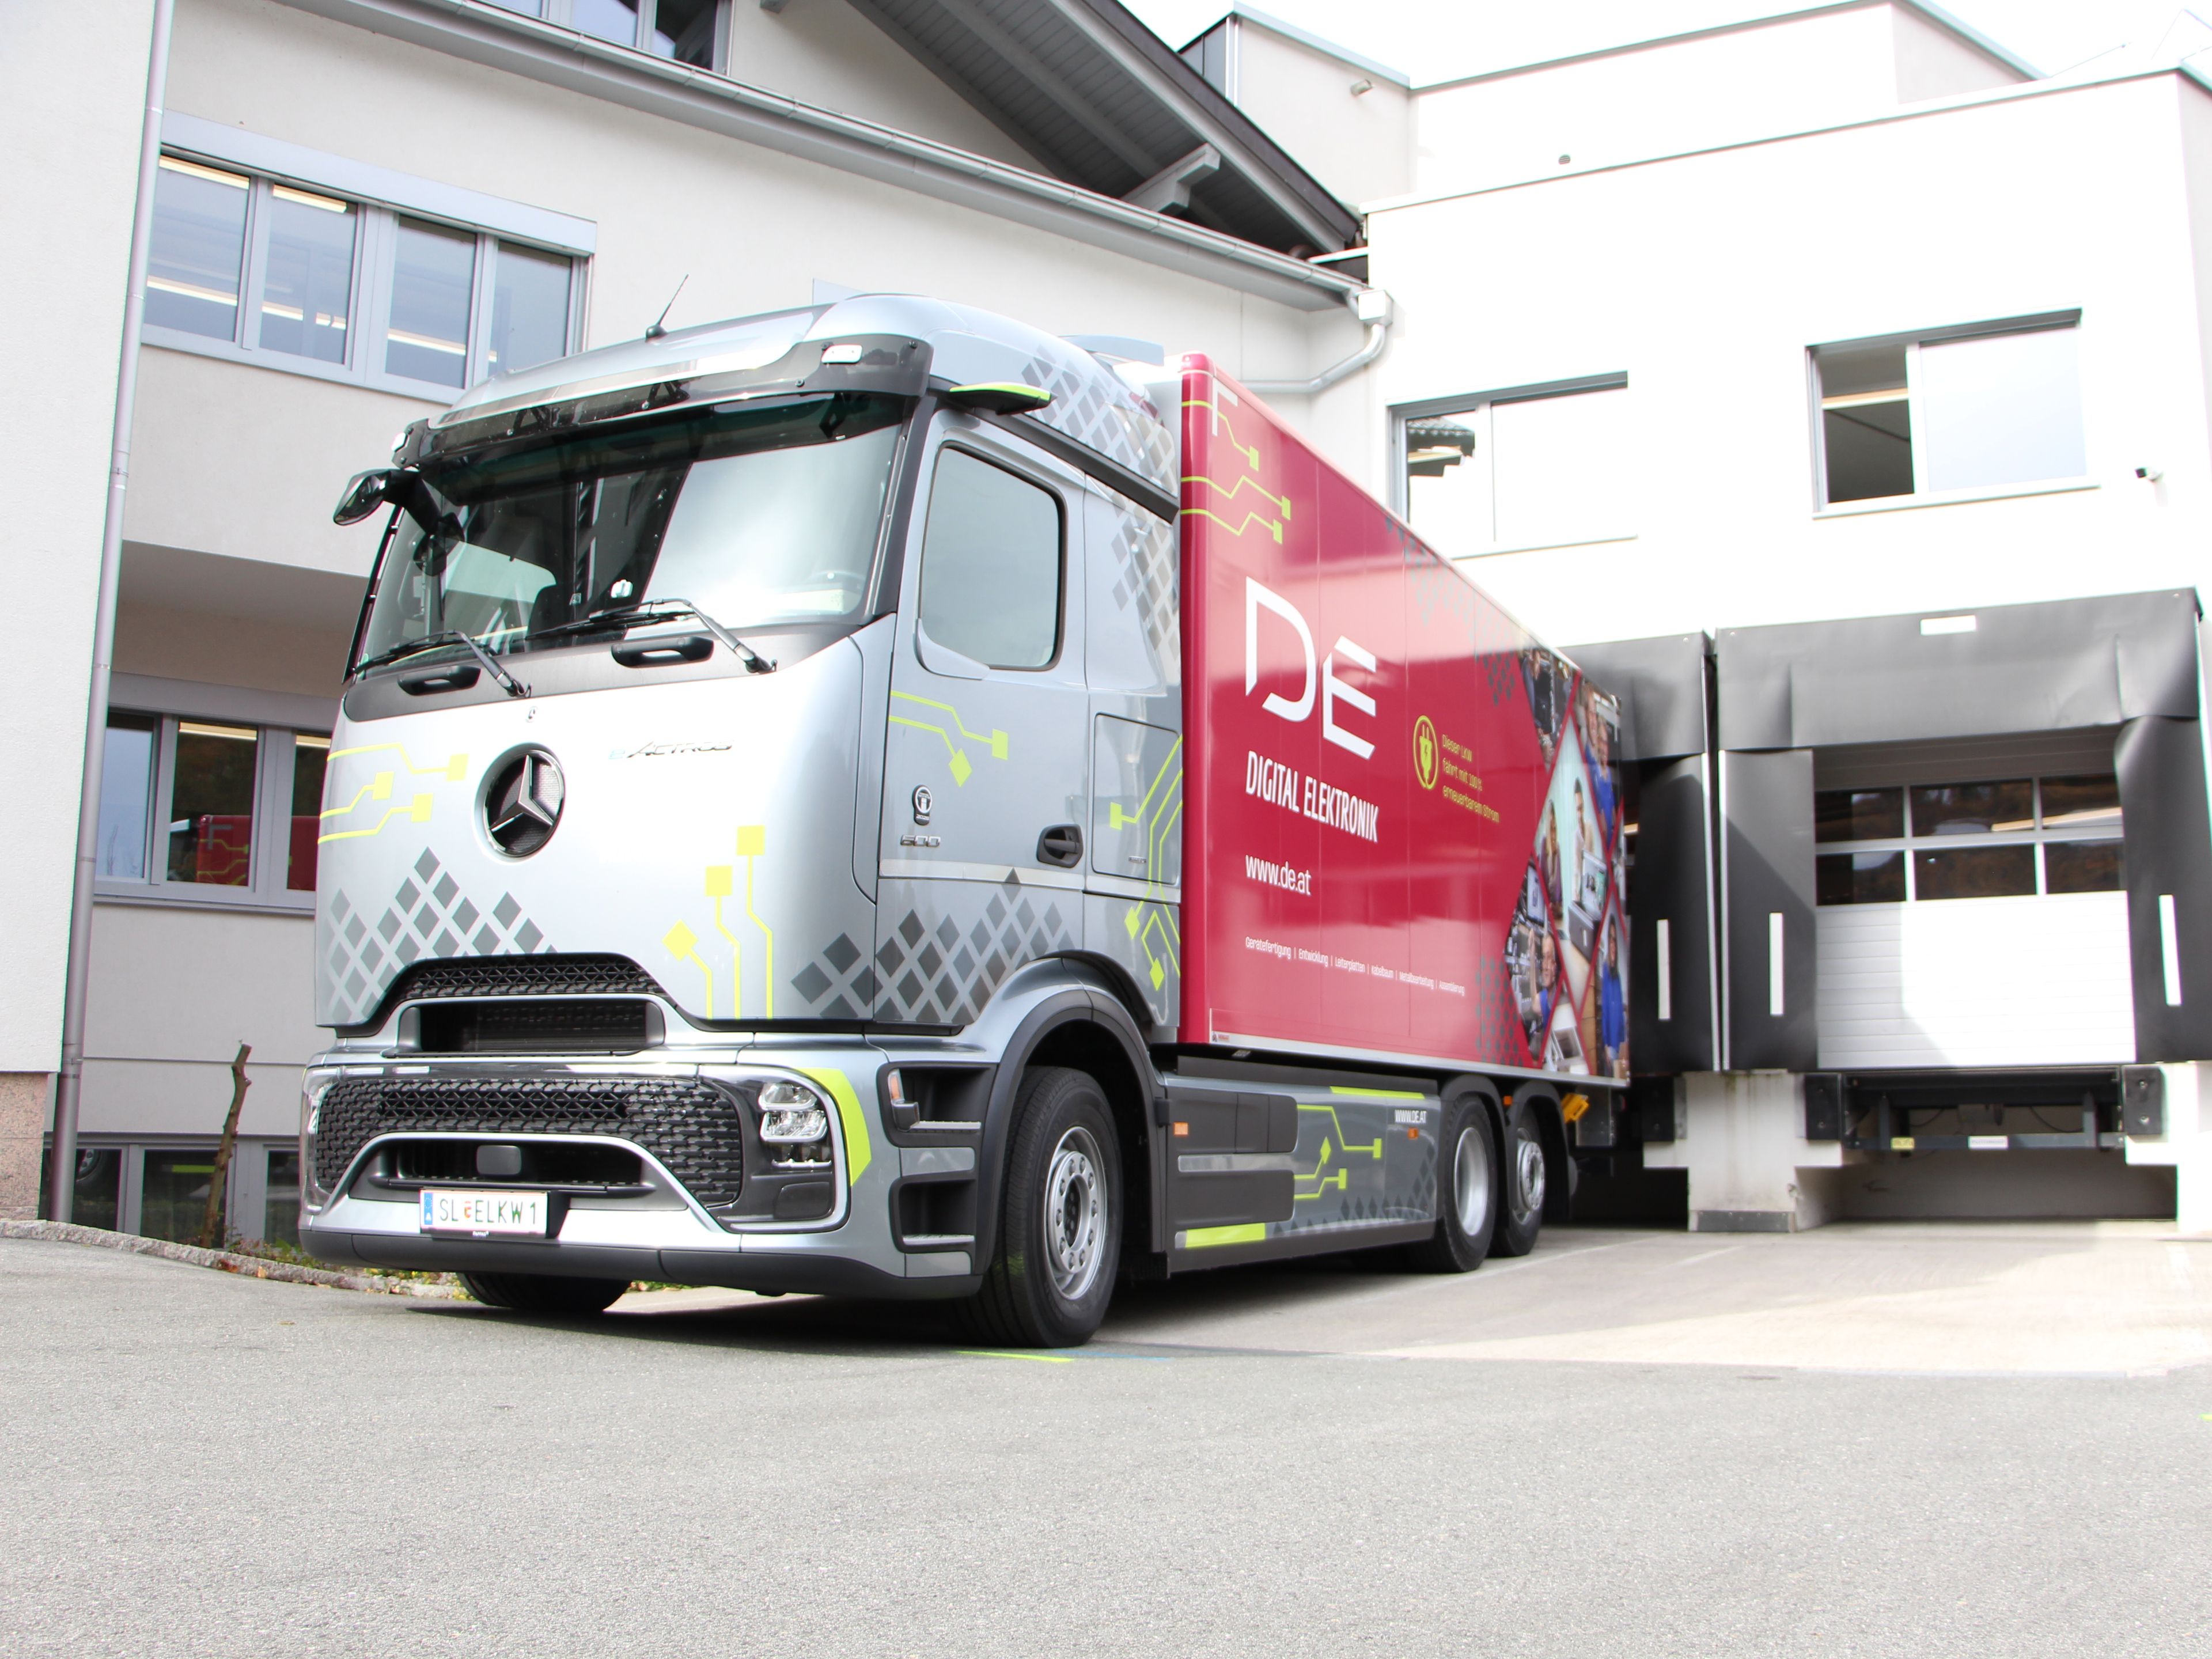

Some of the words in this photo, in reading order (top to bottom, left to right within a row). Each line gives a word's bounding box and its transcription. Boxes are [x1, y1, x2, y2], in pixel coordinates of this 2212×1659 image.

[1245, 576, 1376, 760] DE
[1442, 734, 1459, 755] Dieser
[1461, 745, 1472, 762] LKW
[1442, 757, 1459, 779] fahrt
[1459, 768, 1468, 784] mit
[1245, 750, 1300, 813] DIGITAL
[1304, 775, 1378, 843] ELEKTRONIK
[1443, 785, 1483, 815] erneuerbarem
[1483, 804, 1499, 823] Strom
[900, 835, 941, 847] 600
[1245, 854, 1311, 896] www.de.at
[1298, 948, 1328, 967] Entwicklung
[1335, 956, 1365, 972] Leiterplatten
[1395, 1109, 1427, 1124] WWW.DE.AT
[440, 1199, 459, 1222] SL
